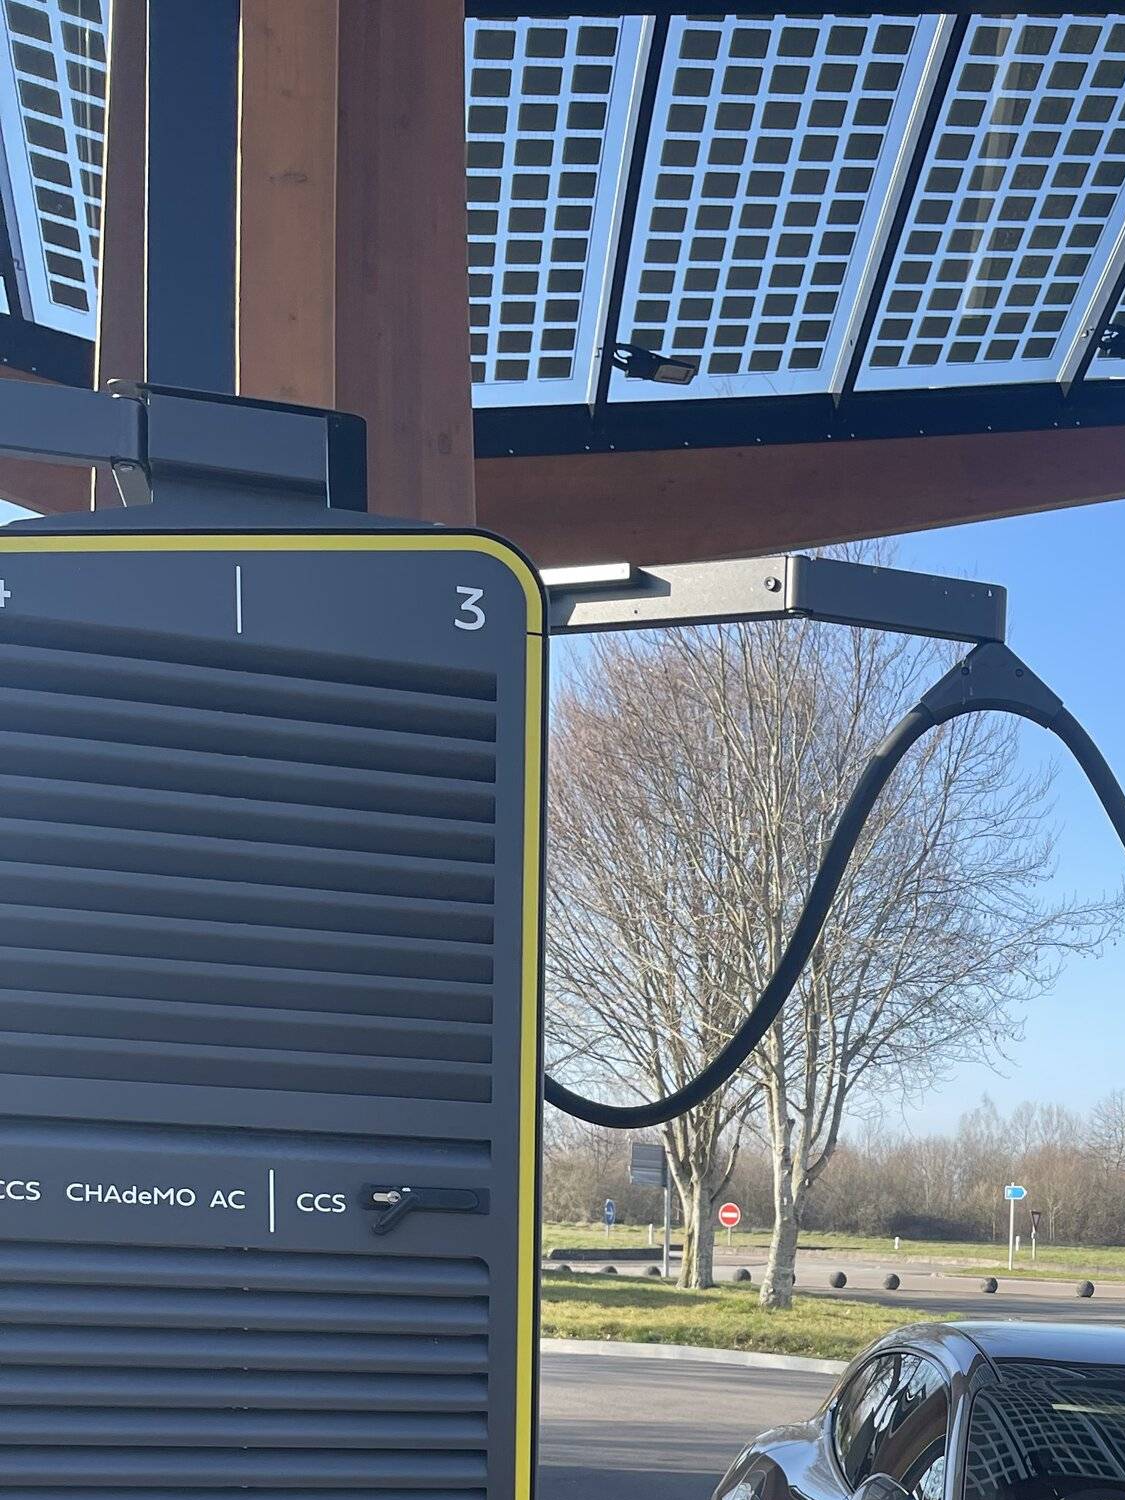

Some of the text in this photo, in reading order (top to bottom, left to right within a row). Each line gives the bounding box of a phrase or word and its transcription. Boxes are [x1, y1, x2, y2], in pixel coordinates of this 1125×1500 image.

[455, 585, 486, 631] 3
[0, 1180, 246, 1210] CS CHAdeMO AC
[296, 1193, 346, 1213] CCS
